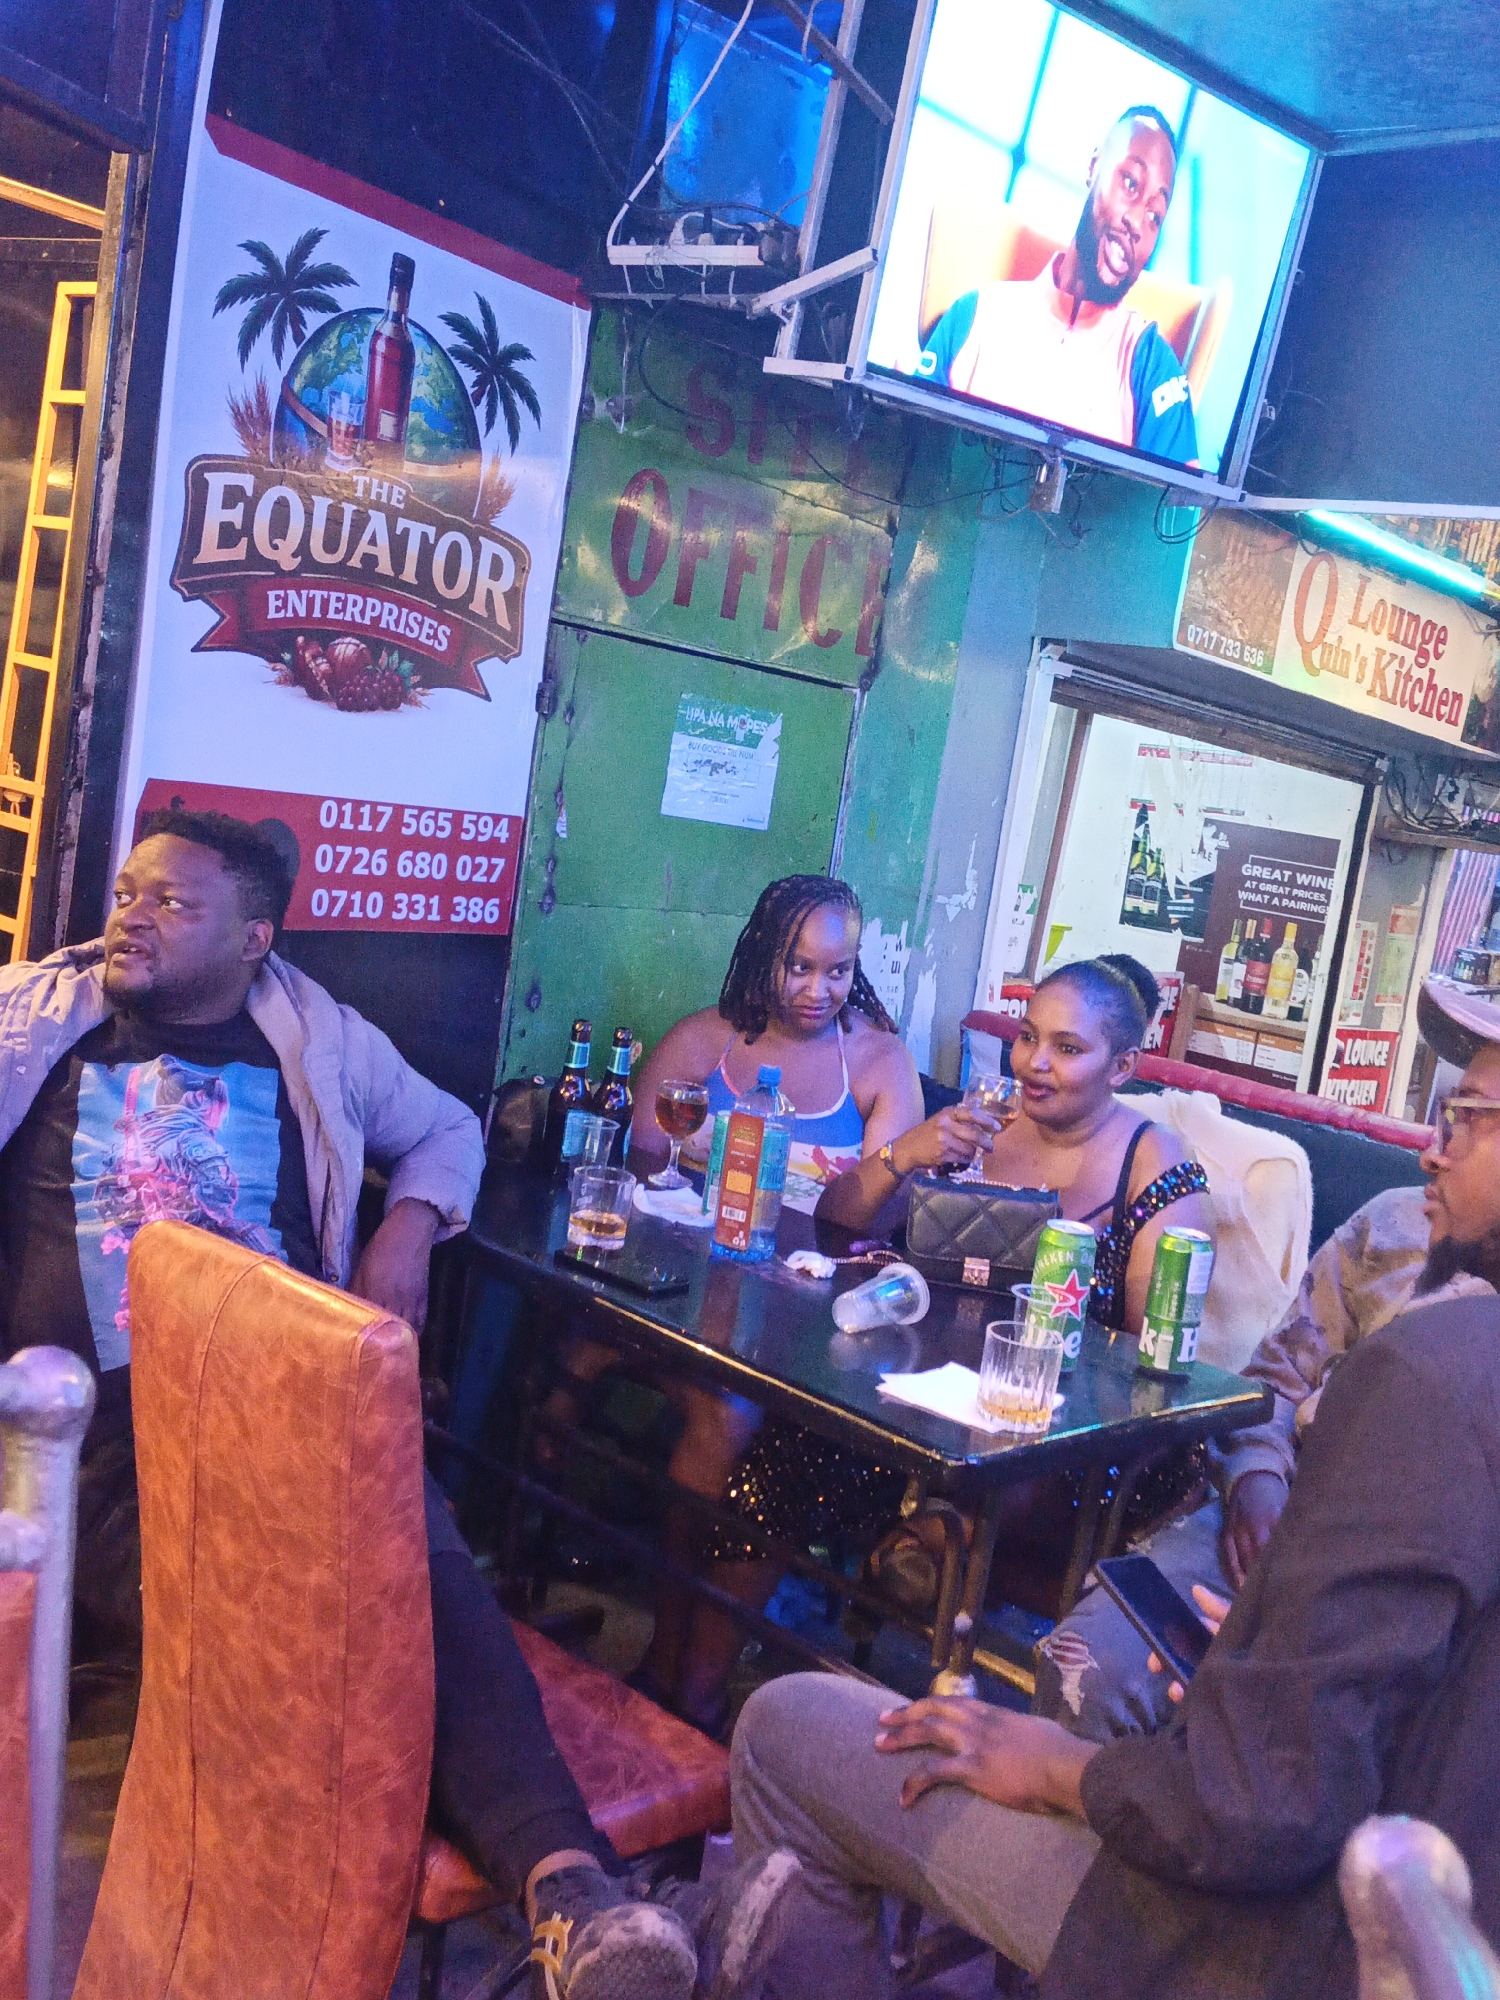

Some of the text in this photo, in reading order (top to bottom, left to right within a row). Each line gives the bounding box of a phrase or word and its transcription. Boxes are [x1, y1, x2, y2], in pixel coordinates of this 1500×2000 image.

[353, 475, 406, 510] THE
[193, 472, 518, 631] EQUATOR
[267, 589, 451, 652] ENTERPRISES
[1348, 573, 1449, 669] Lounge
[1187, 624, 1265, 667] 0717 733 636
[1366, 646, 1464, 727] Kitchen
[685, 706, 706, 724] LIPA
[709, 710, 725, 728] NA
[319, 800, 510, 844] 0117 565 594
[314, 844, 505, 884] 0726 680 027
[1241, 863, 1293, 883] GREAT
[310, 888, 500, 924] 0710 331 386
[1238, 890, 1270, 904] WHAT
[1271, 898, 1280, 907] A
[1244, 880, 1328, 904] AT GREAT PRICES,
[1343, 1038, 1391, 1067] LOUNGE
